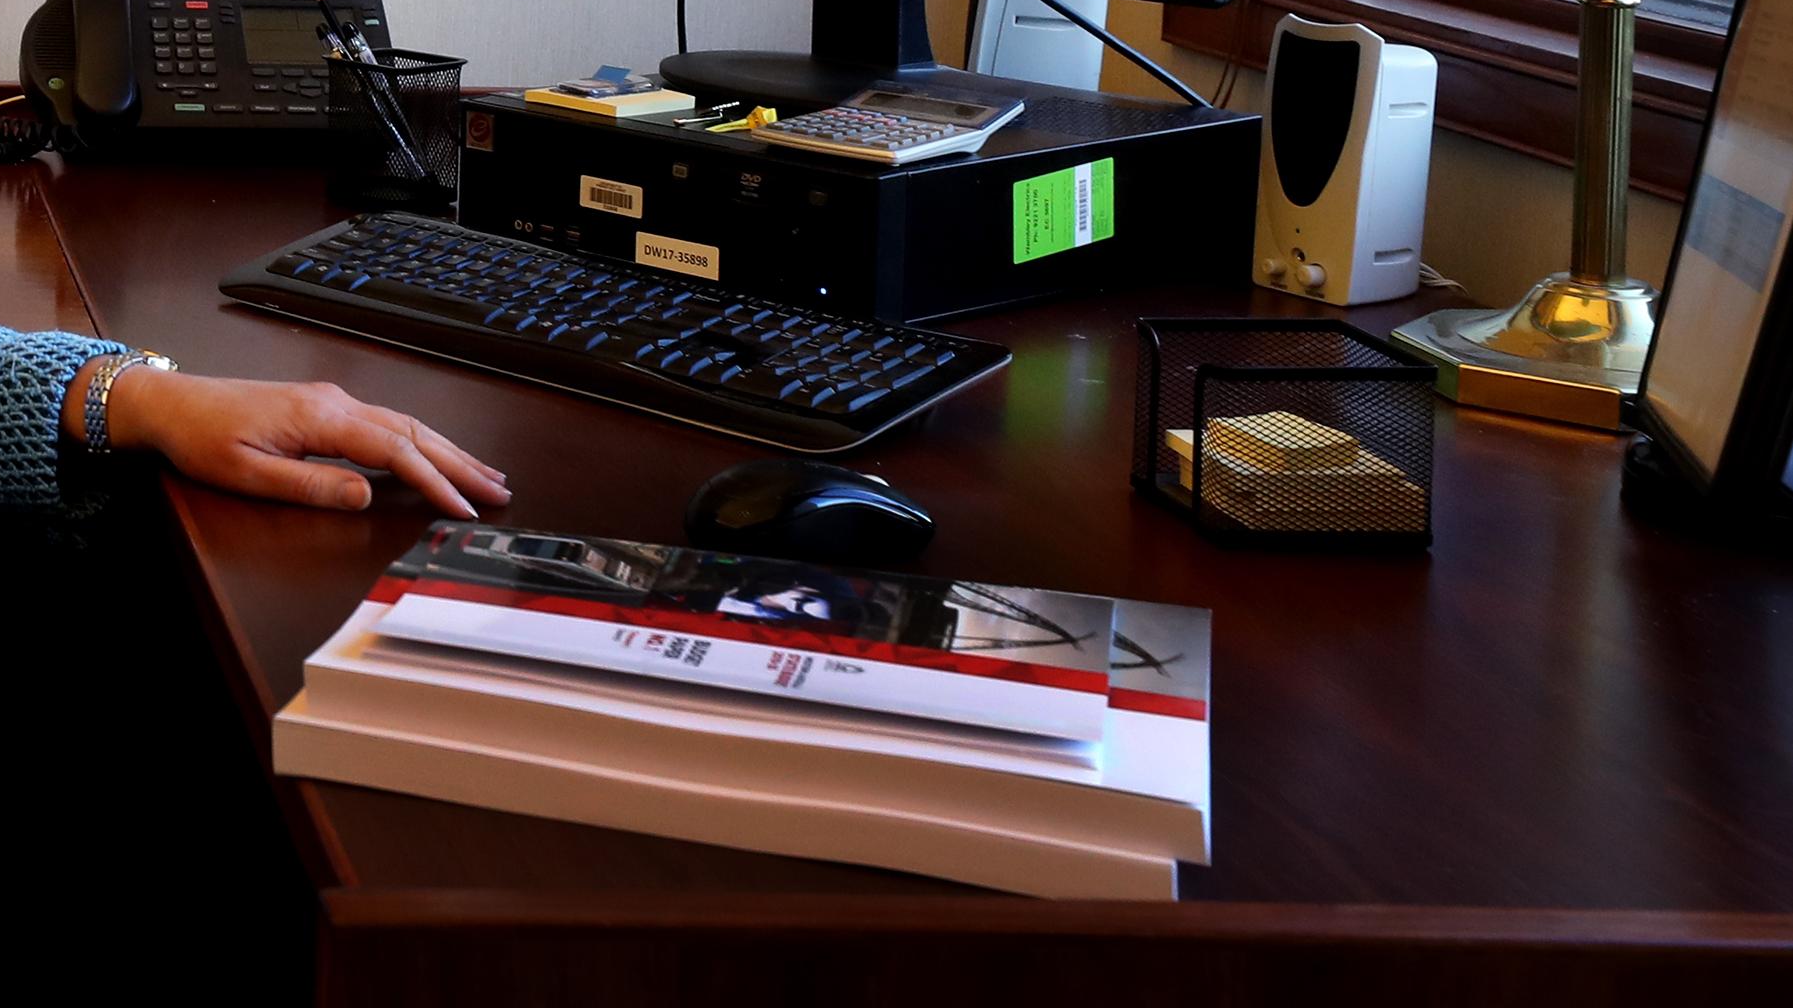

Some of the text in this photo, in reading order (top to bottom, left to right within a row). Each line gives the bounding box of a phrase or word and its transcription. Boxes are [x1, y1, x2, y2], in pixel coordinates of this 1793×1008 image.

[741, 173, 762, 183] DVD
[644, 245, 708, 268] DW17-35898
[684, 639, 712, 667] BUDGET
